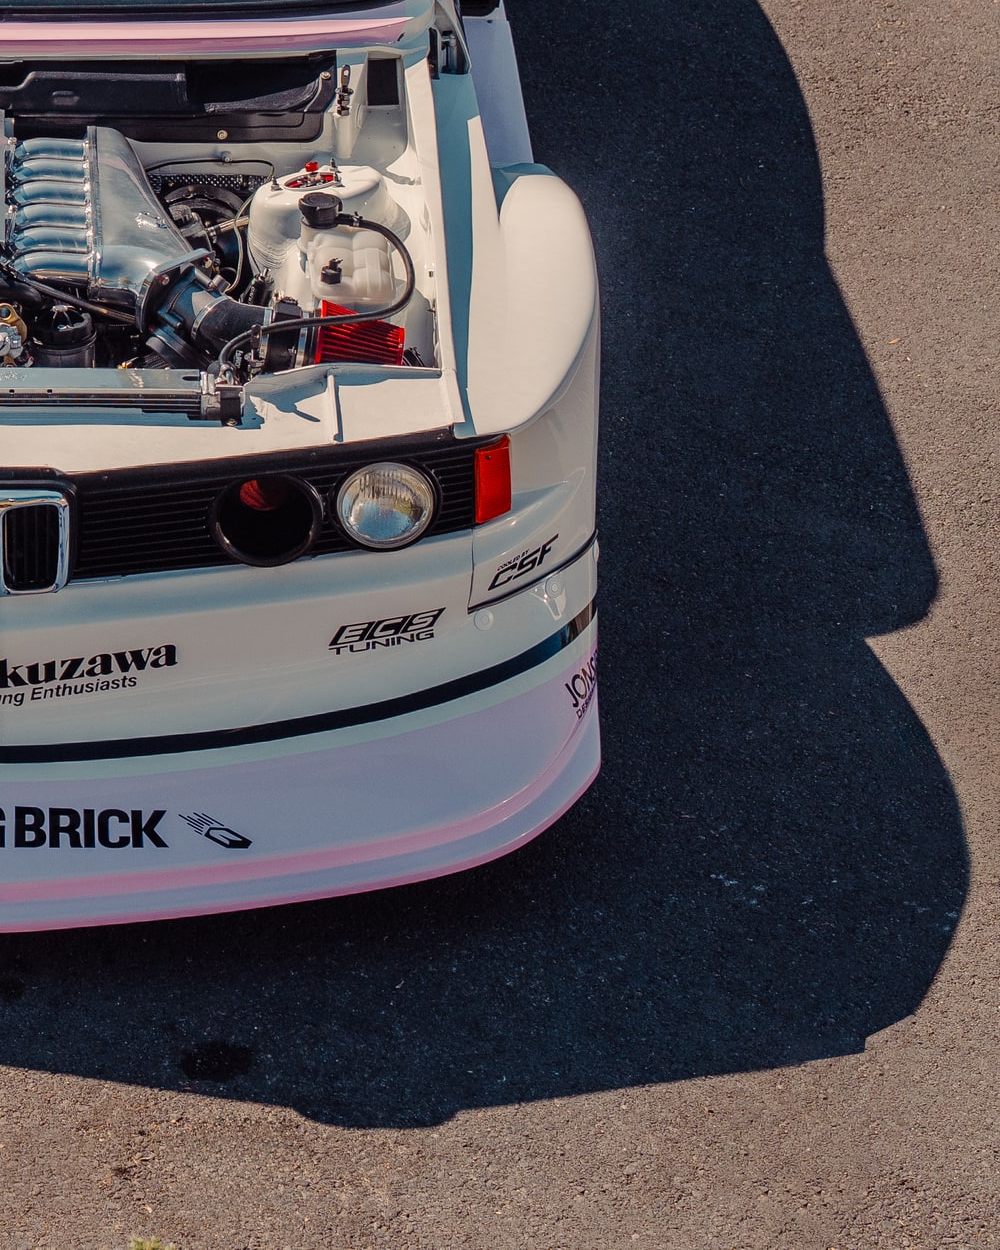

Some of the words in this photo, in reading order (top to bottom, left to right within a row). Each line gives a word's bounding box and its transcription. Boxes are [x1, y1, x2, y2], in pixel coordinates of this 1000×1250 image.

[488, 533, 559, 592] CSF
[328, 629, 435, 655] TUNING
[330, 607, 446, 646] ECS
[30, 675, 138, 701] Enthusiasts
[13, 806, 169, 848] BRICK
